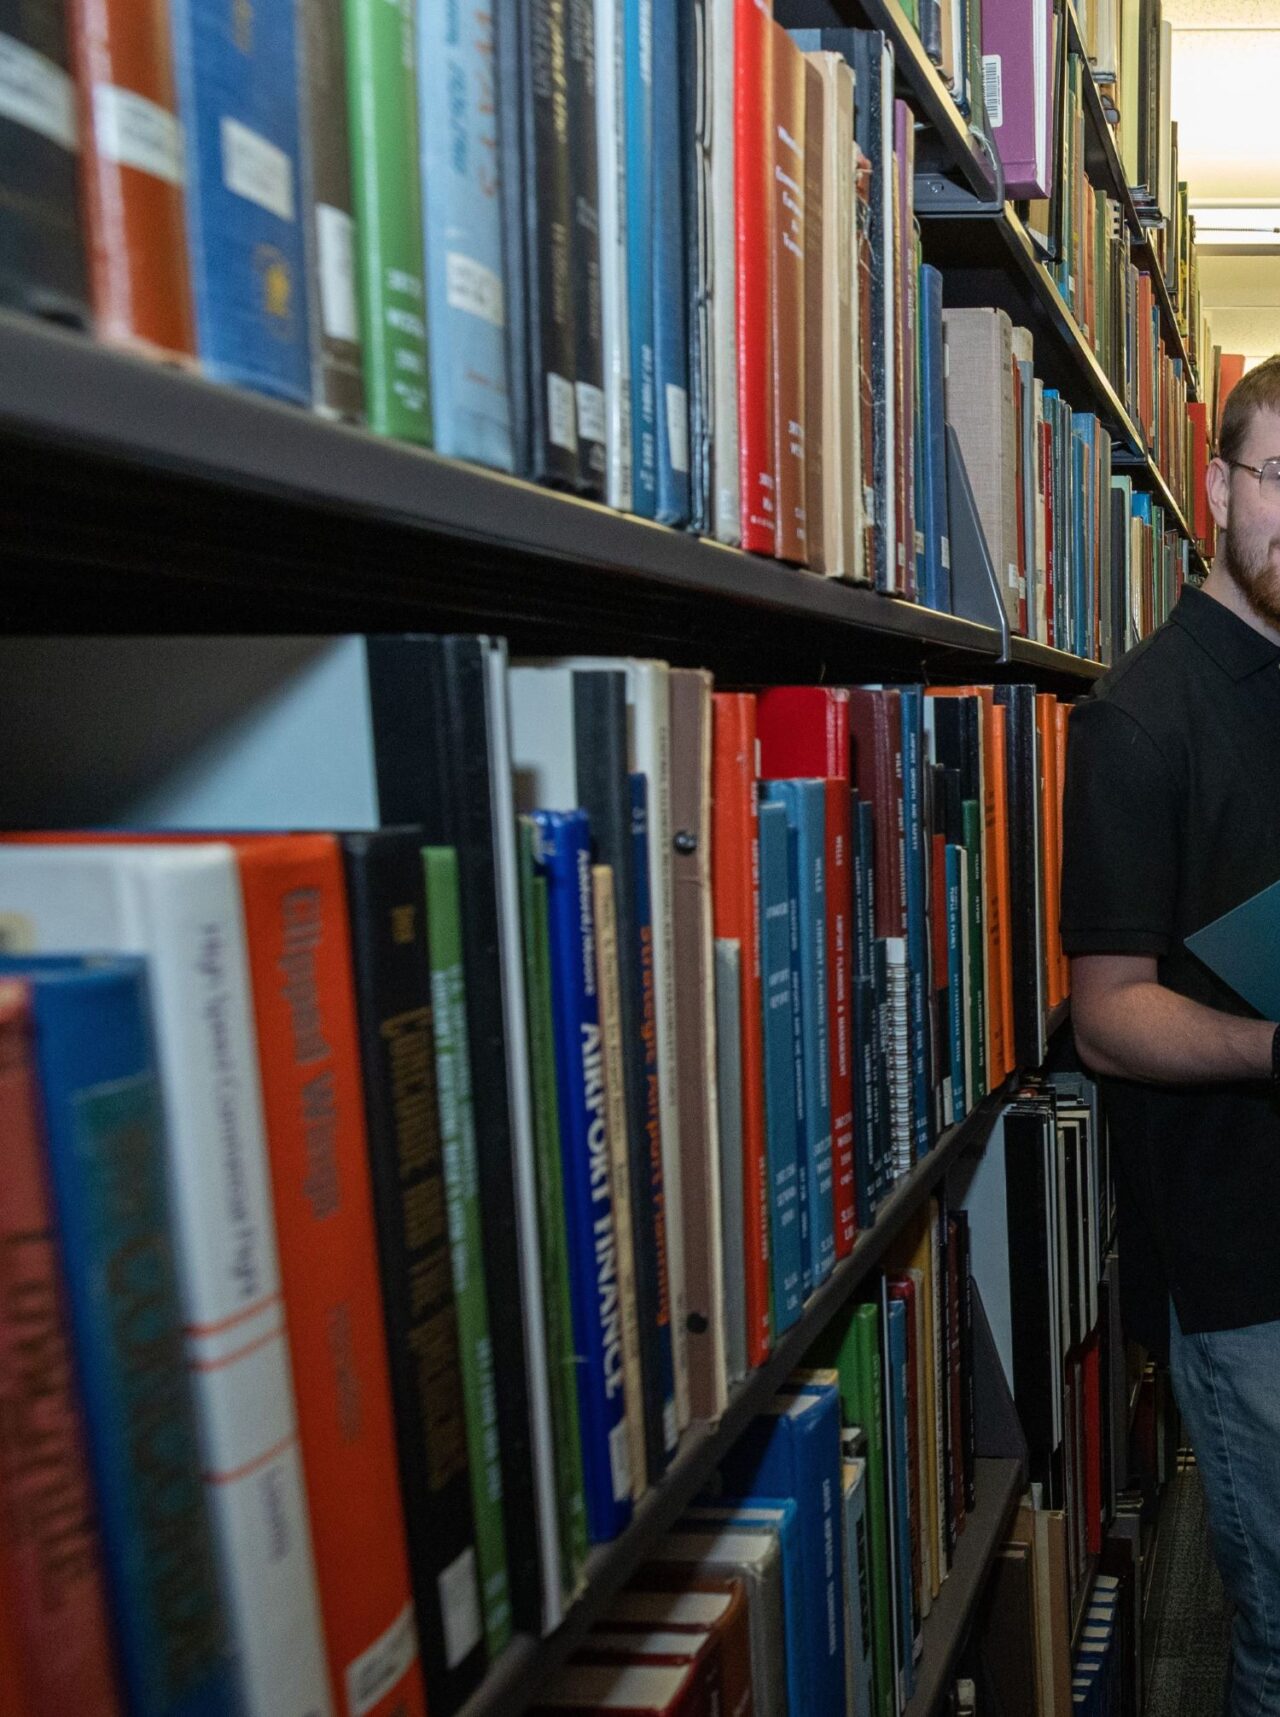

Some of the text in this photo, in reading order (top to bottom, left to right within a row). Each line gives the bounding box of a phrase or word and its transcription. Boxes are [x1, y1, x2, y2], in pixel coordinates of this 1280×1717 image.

[895, 752, 903, 779] WILEY
[897, 797, 905, 832] AIRPORT
[911, 822, 919, 851] SAFETY
[814, 857, 823, 893] WELLS
[834, 835, 844, 867] WELLS
[577, 849, 596, 997] Ashford/Moore
[816, 918, 825, 966] AIRPORT
[835, 914, 844, 952] AIRPORT
[276, 887, 334, 1065] Clipped
[816, 969, 826, 1026] PLANNING
[836, 955, 845, 1002] PLANNING
[837, 1016, 847, 1077] MANAGEMENT
[818, 1038, 828, 1108] MANAGEMENT
[580, 1022, 612, 1203] AIRPORT
[639, 925, 670, 1327] Strategic Airport Planning
[593, 1213, 624, 1400] FINANCE
